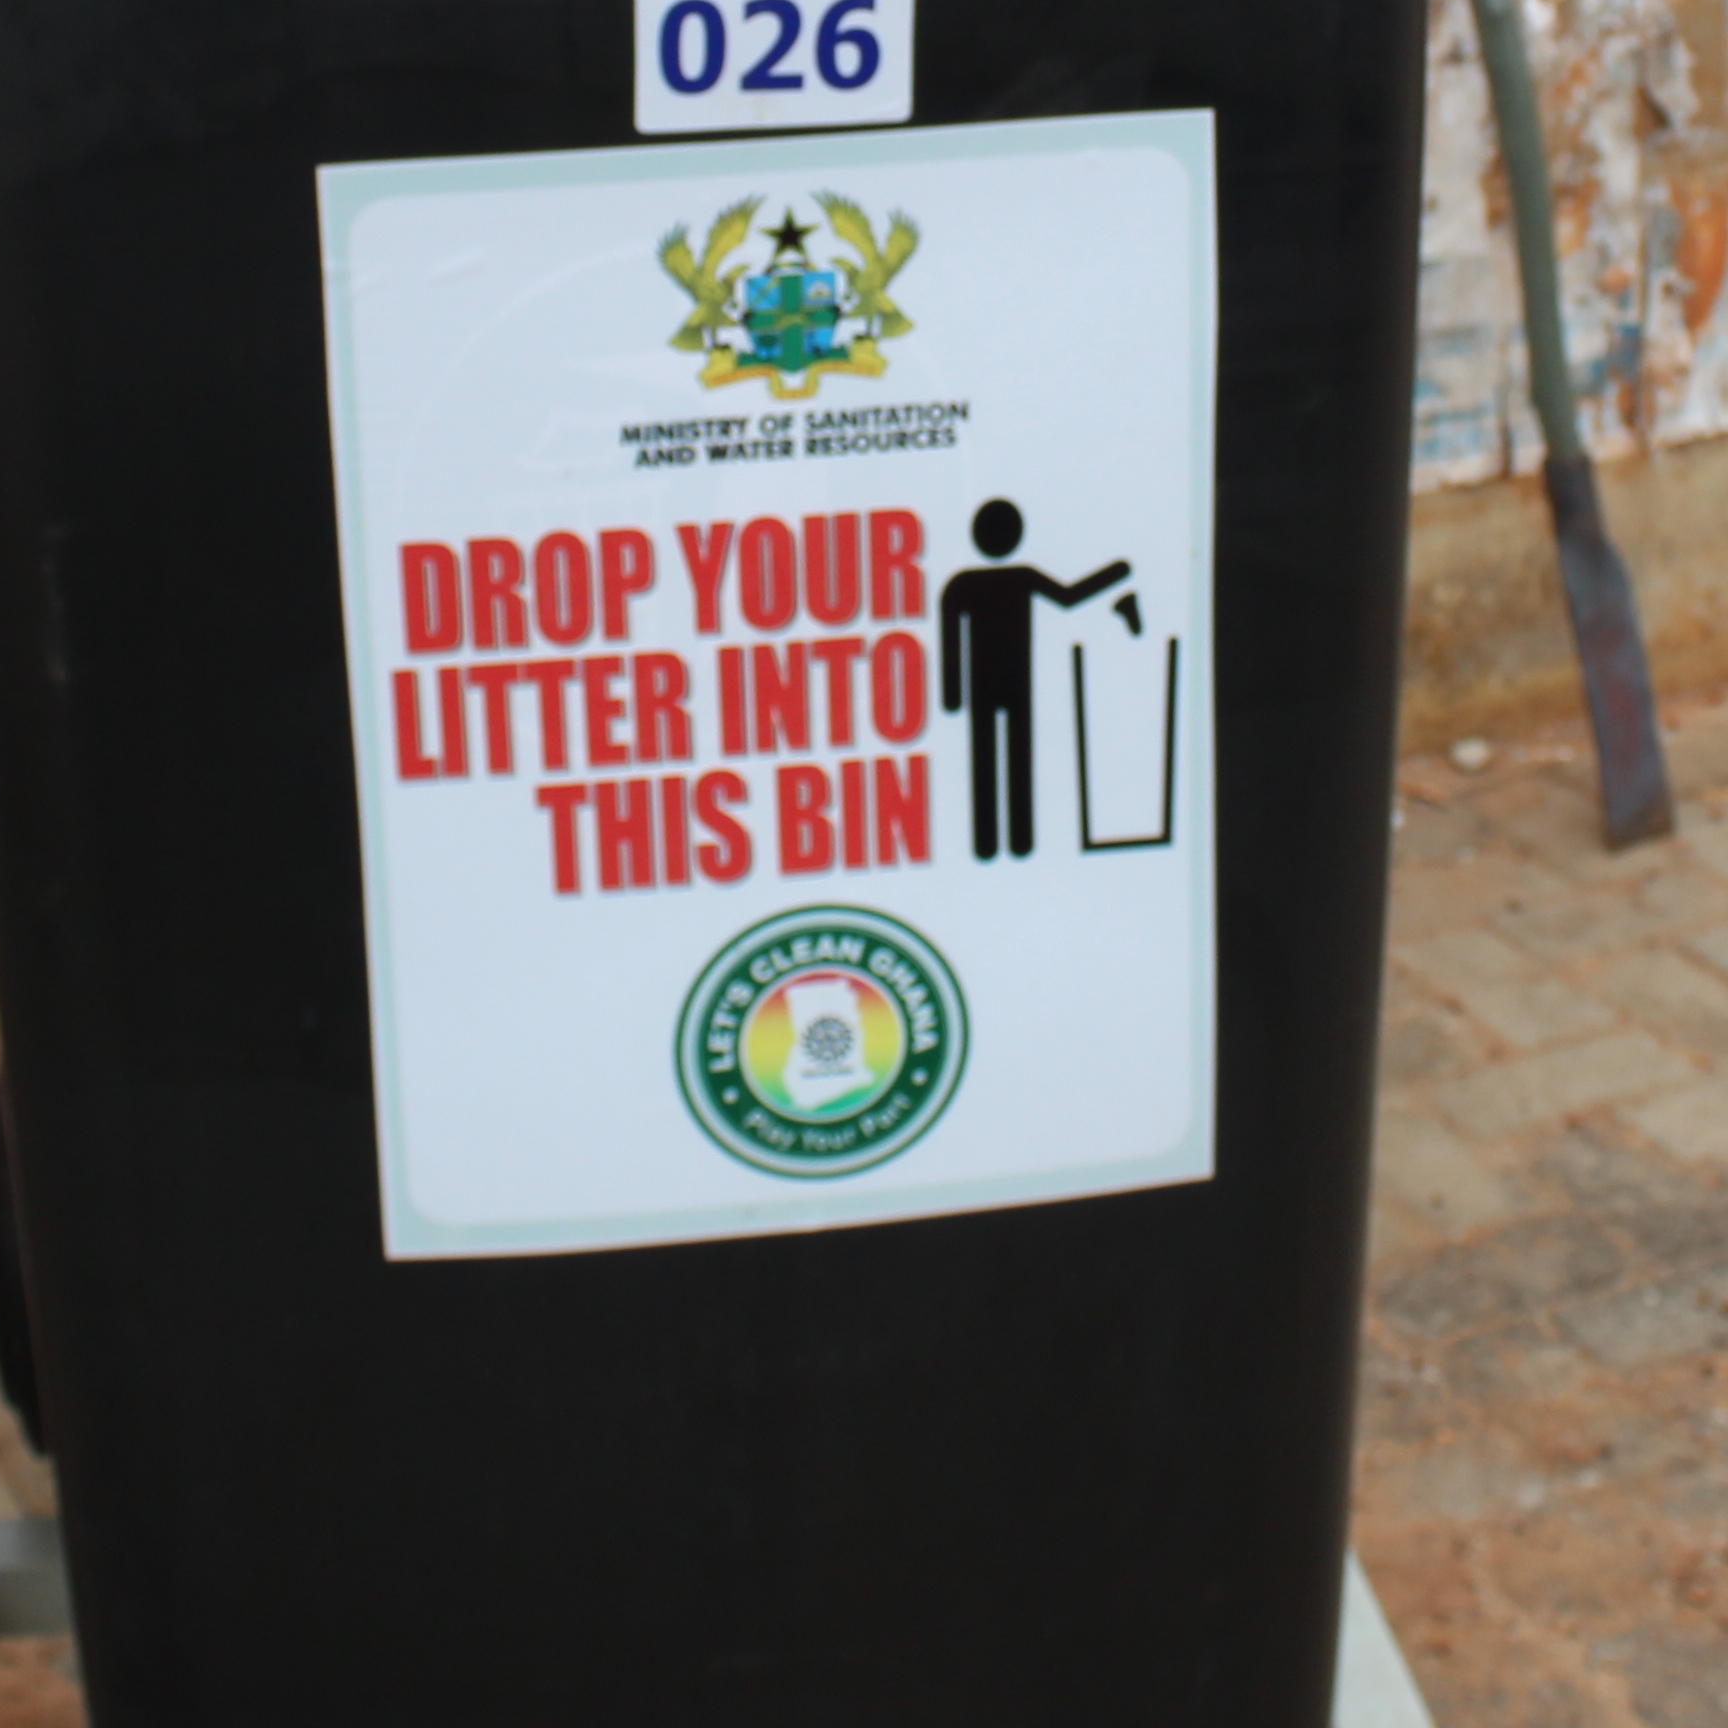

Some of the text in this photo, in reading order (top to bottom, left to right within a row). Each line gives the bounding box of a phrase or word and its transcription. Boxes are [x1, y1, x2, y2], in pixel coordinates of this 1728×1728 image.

[620, 402, 969, 446] MINISTRY OF SANITATION
[635, 427, 957, 468] AND WATER RESOURCES
[399, 509, 926, 654] DROP YOUR
[391, 631, 928, 782] LITTER INTO
[536, 754, 932, 895] THIS BIN
[708, 933, 939, 1073] LET'S CLEAN GHANA
[743, 1108, 796, 1152] Play
[800, 1126, 858, 1152] Your
